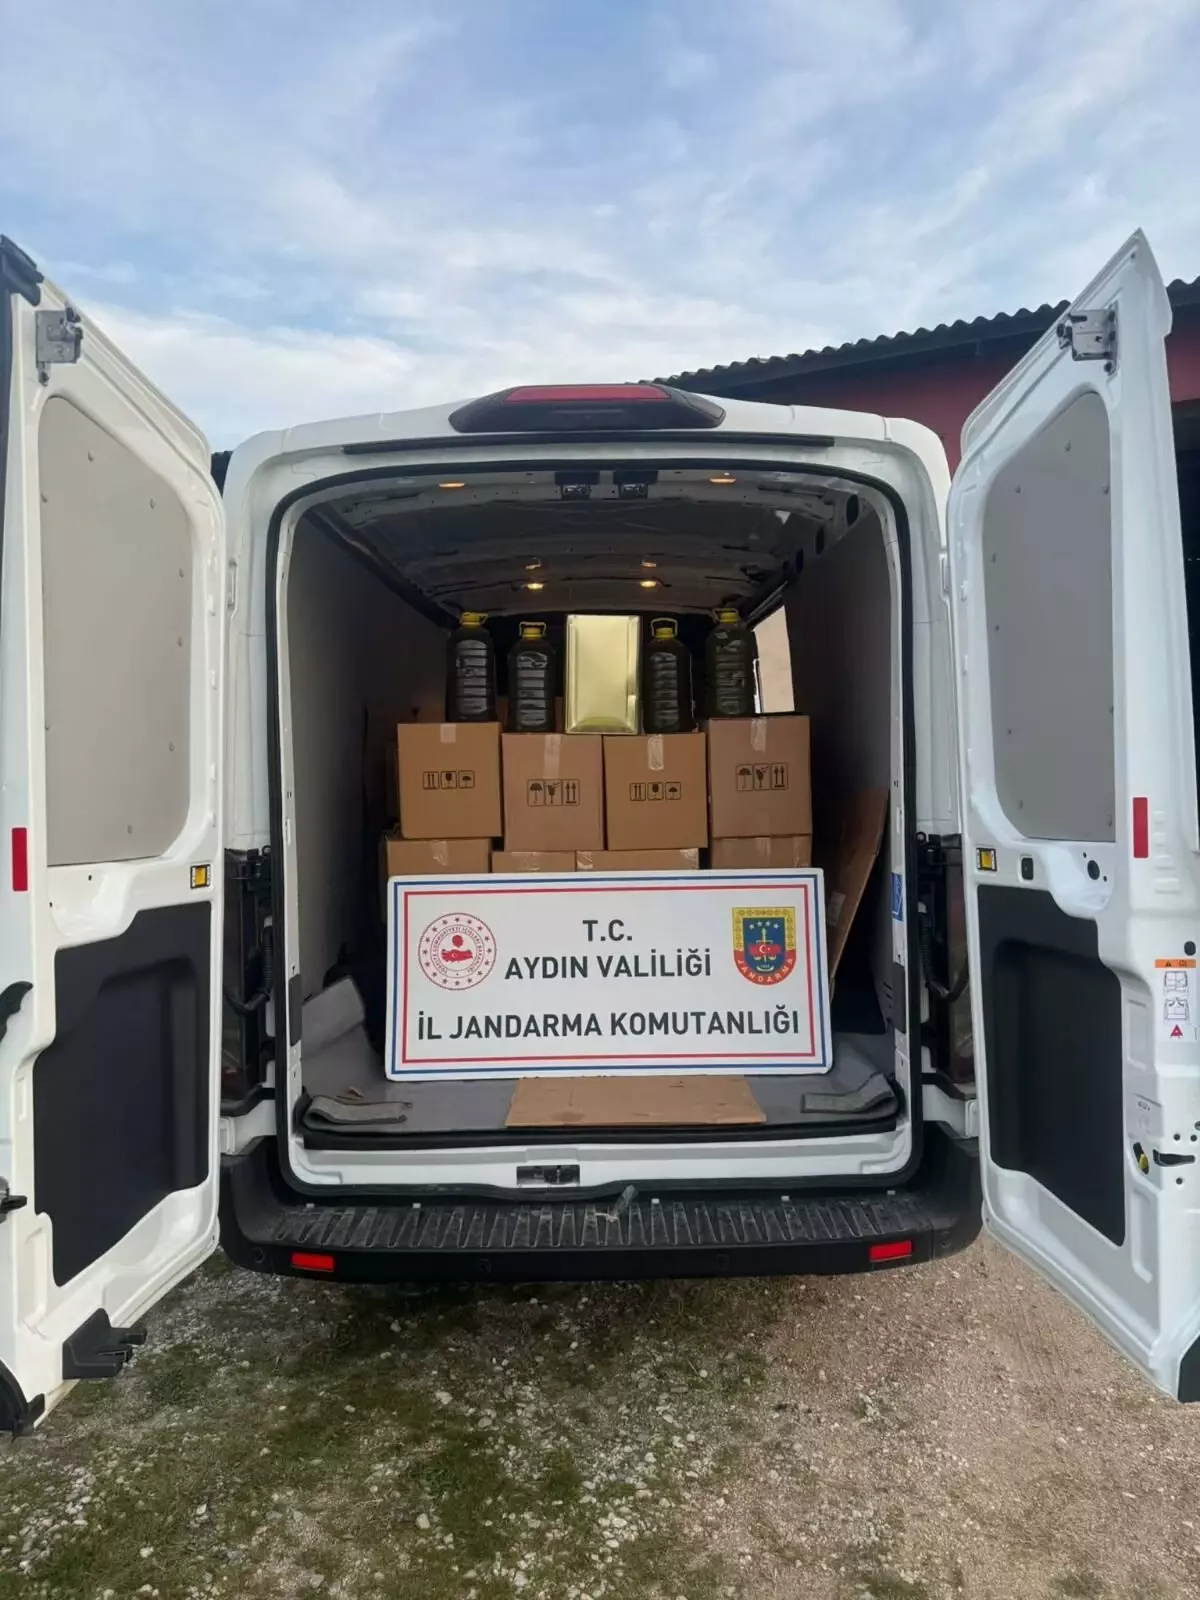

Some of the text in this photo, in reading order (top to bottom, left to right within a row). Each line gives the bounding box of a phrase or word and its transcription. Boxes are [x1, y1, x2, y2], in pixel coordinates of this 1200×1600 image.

[582, 919, 633, 942] T.C.
[505, 948, 711, 980] AYDIN VALİLİĞİ
[737, 958, 793, 982] JANDARMA
[418, 1004, 799, 1040] İL JANDARMA KOMUTANLIĞI
